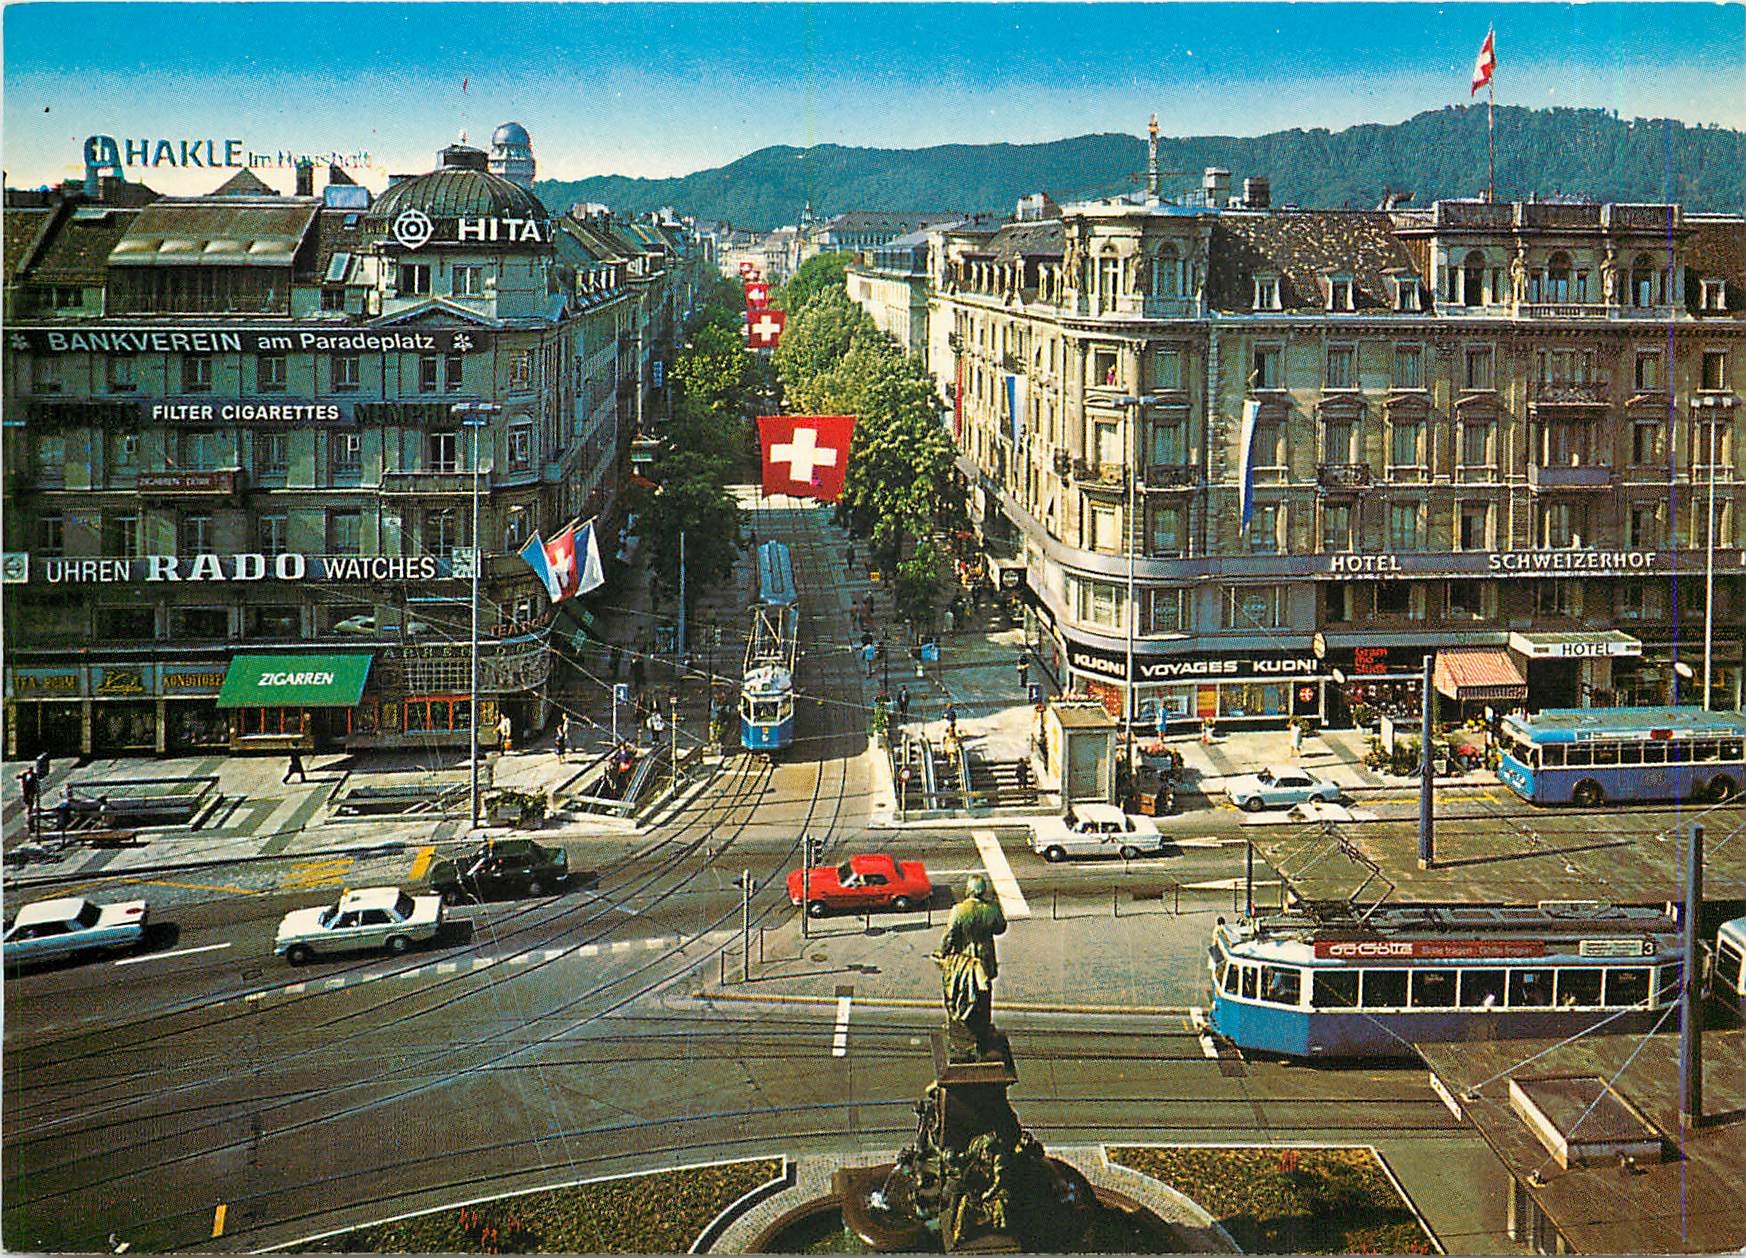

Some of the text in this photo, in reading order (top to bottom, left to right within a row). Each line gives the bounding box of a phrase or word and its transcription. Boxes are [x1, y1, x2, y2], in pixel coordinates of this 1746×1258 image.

[125, 138, 243, 168] HAKLE
[458, 217, 553, 242] HITA
[48, 332, 436, 351] BANKVEREIN am Paradeplatz
[152, 405, 213, 420] FILTER
[221, 405, 340, 420] CIGARETTES
[46, 560, 130, 583] UHREN
[146, 553, 306, 581] RADO
[323, 556, 437, 579] WATCHES
[1330, 552, 1658, 572] HOTEL SCHWEIZERHOF
[1561, 643, 1615, 657] HOTEL
[1073, 652, 1318, 678] KUONI VOYAGES KUONI
[257, 672, 335, 687] ZIGARREN
[1643, 942, 1654, 955] 3
